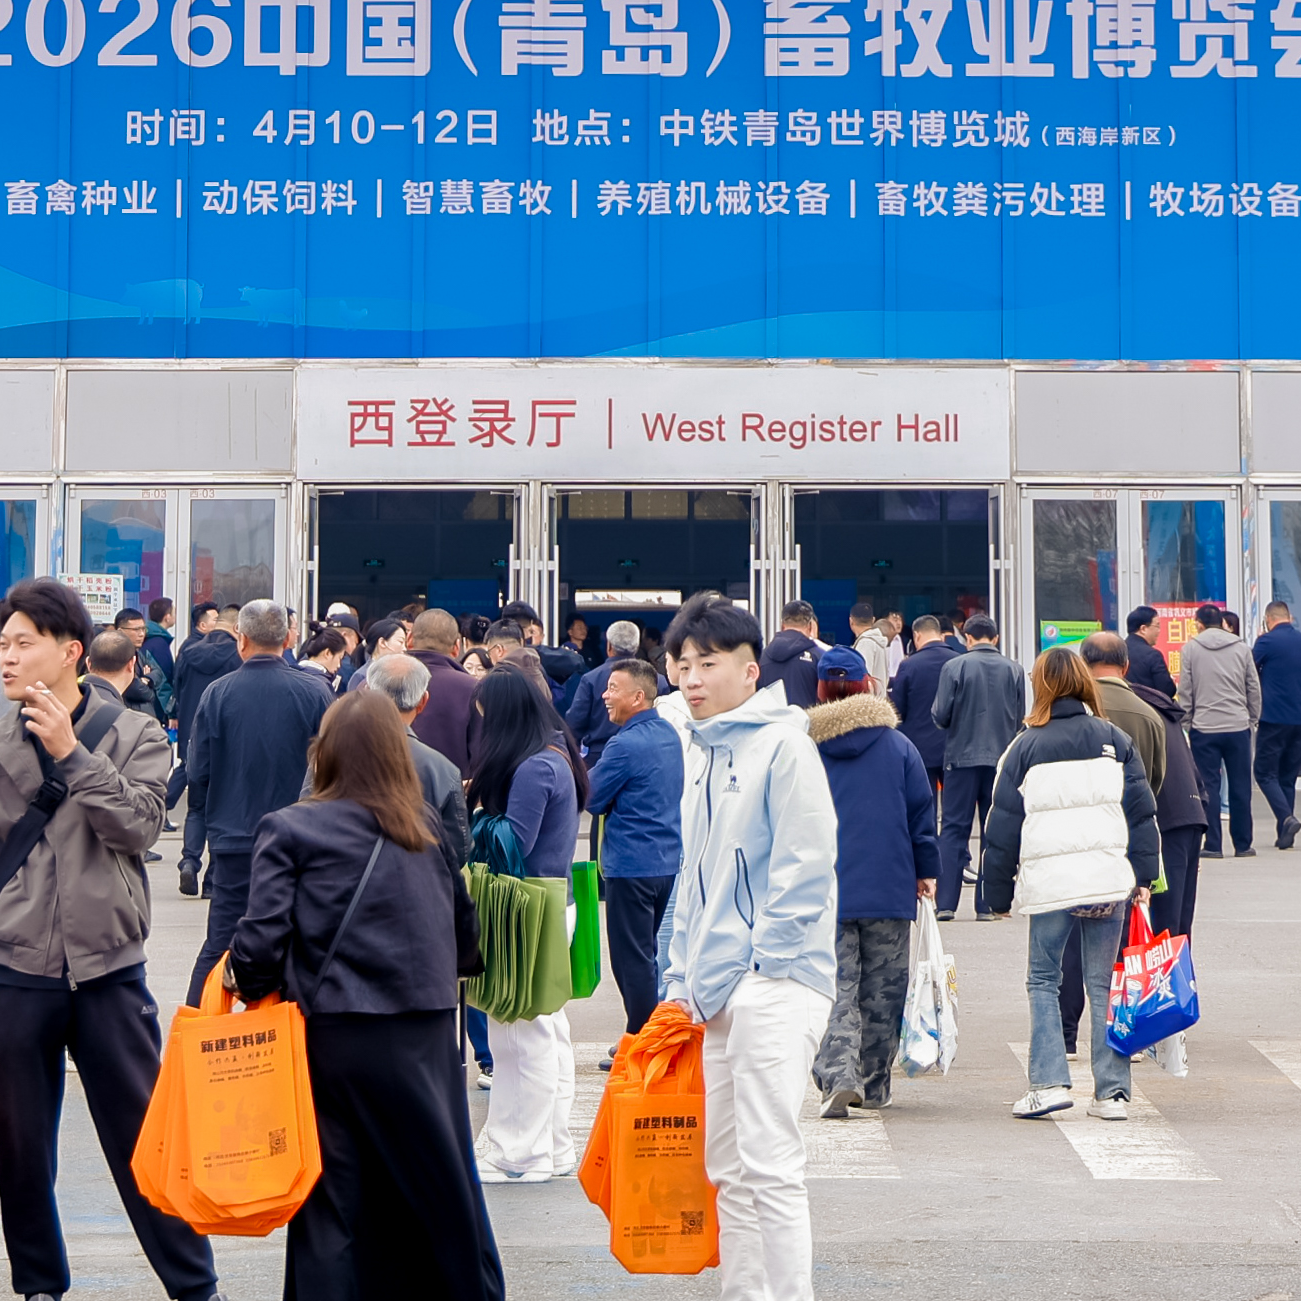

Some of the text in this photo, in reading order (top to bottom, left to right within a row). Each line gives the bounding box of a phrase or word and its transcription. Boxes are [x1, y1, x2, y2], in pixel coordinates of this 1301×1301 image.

[4, 179, 158, 216] 畜禽种业
[202, 179, 357, 215] 动保饲料
[402, 178, 552, 215] 智慧畜牧
[596, 179, 831, 217] 养殖机械设备
[875, 180, 1106, 218] 畜牧粪污处理
[348, 397, 578, 449] 西登录厅
[642, 412, 959, 450] West Register Hall
[200, 1028, 277, 1053] 新建塑料制品
[633, 1116, 698, 1130] 新建塑料制品
